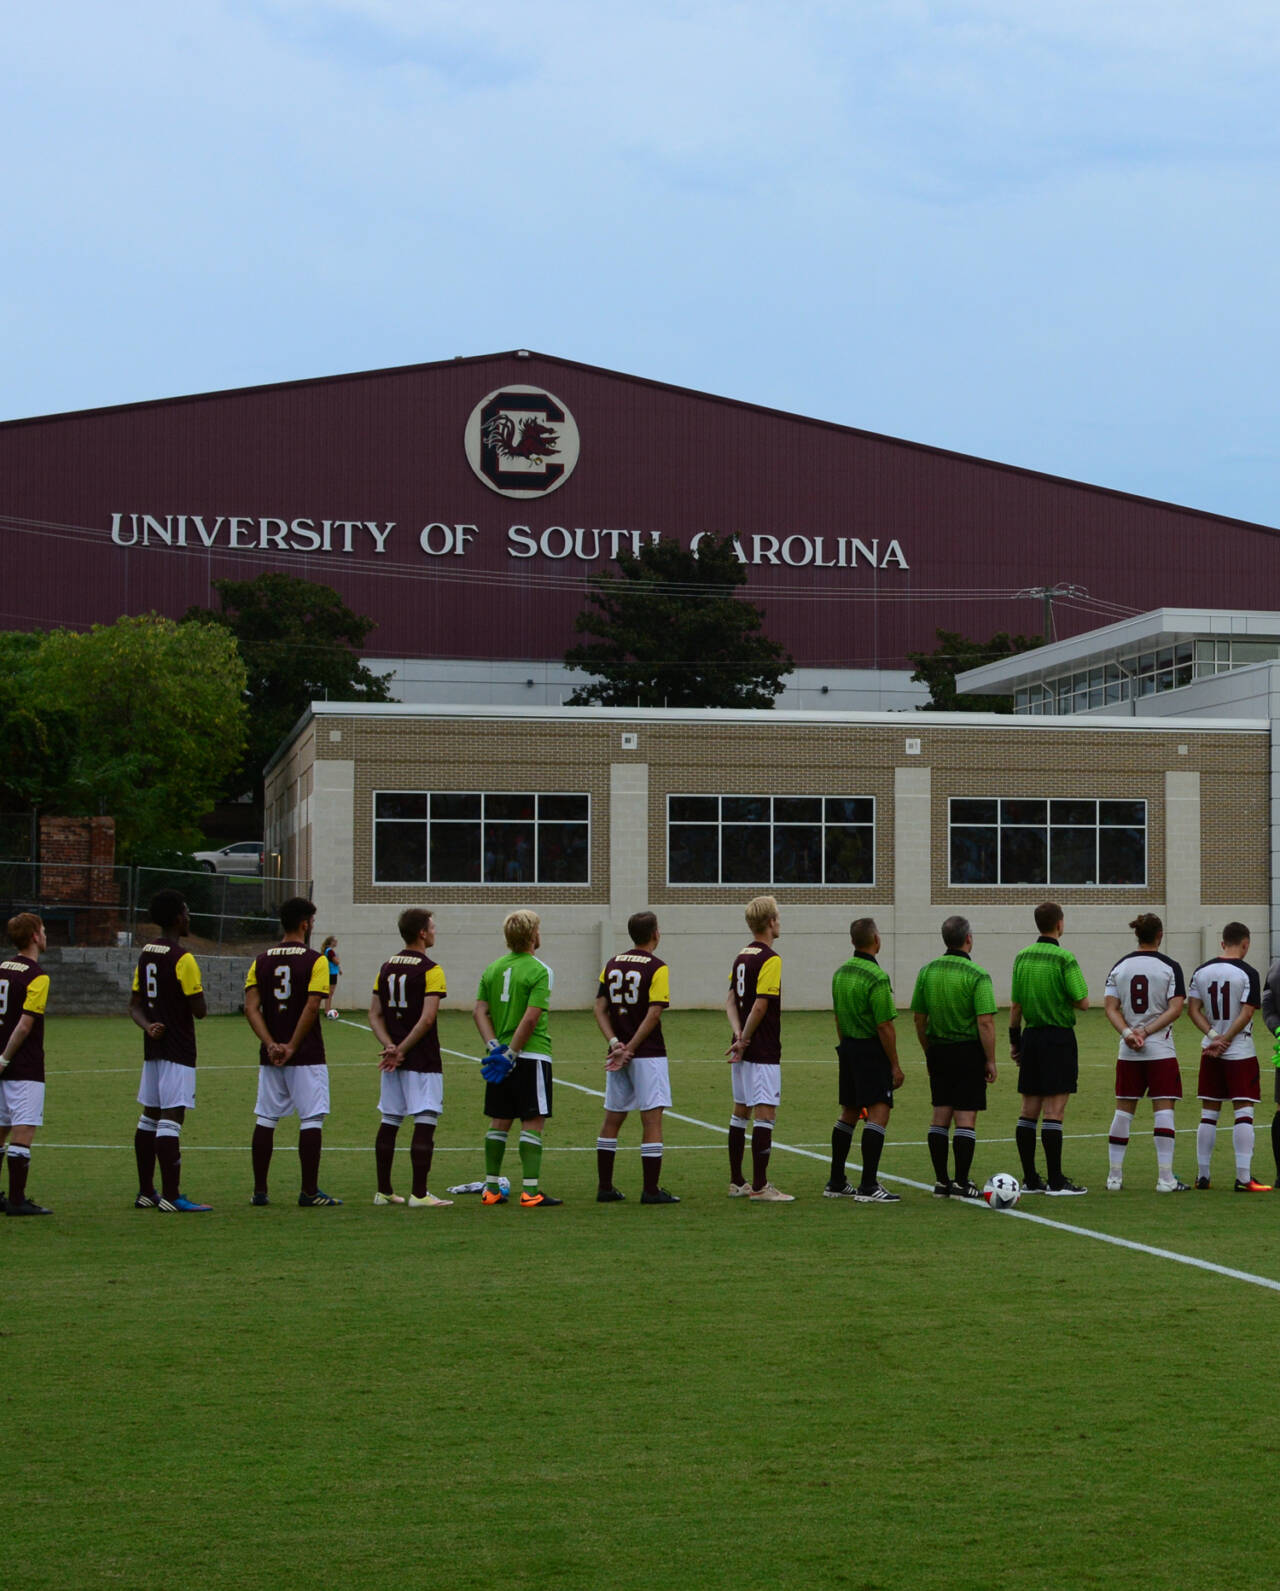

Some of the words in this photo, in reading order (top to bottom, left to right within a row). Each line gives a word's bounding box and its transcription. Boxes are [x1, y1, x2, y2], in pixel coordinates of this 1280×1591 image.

[111, 513, 396, 553] UNIVERSITY
[419, 523, 479, 555] OF
[146, 962, 158, 998] 6
[274, 965, 292, 1000] 3
[387, 973, 408, 1008] 11
[501, 967, 511, 1002] 1
[608, 969, 642, 1005] 23
[736, 963, 746, 998] 8
[1130, 974, 1149, 1014] 8
[1207, 981, 1231, 1020] 11
